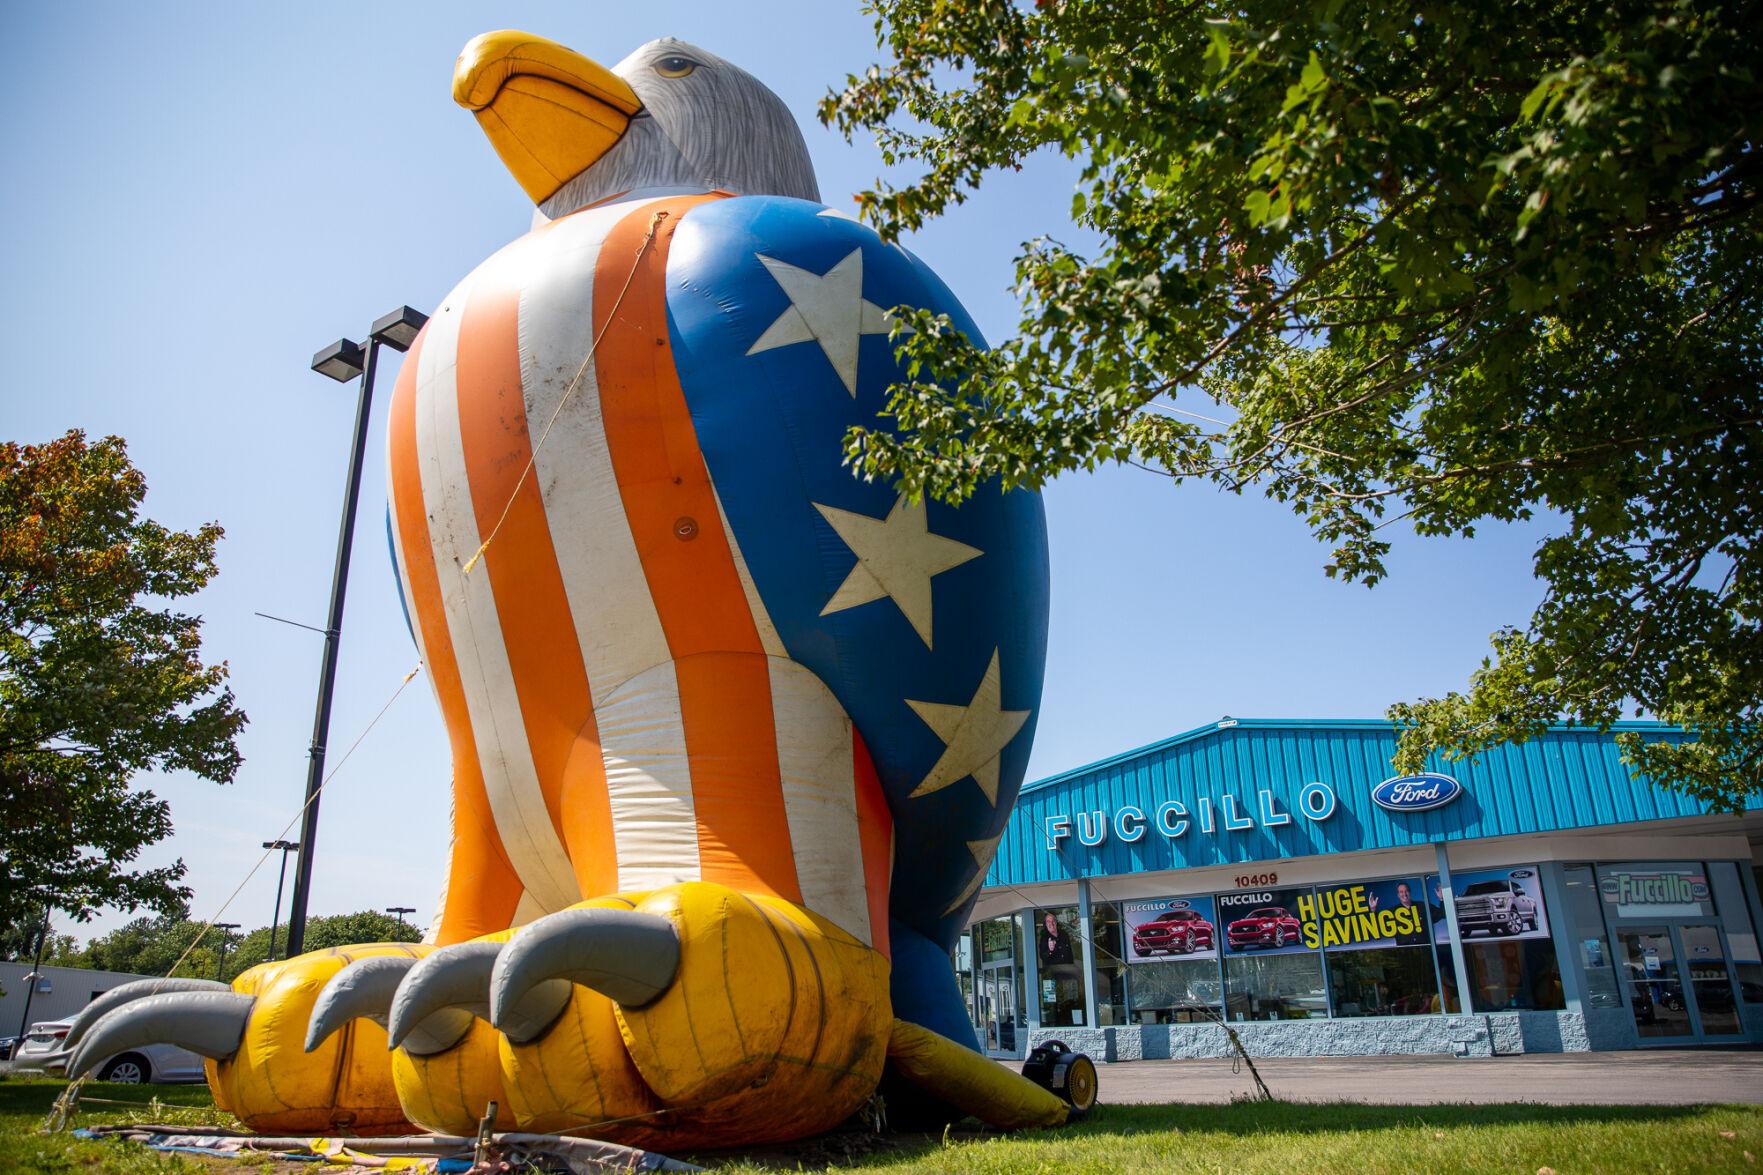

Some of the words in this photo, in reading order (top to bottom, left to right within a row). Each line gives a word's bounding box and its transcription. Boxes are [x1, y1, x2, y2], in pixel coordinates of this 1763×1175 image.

[1390, 780, 1440, 804] Ford
[1045, 781, 1337, 851] FUCCILLO
[1234, 872, 1279, 888] 10409
[1618, 873, 1695, 905] Fuccillo
[1125, 902, 1166, 913] FUCCILLO
[1220, 892, 1273, 907] FUCCILLO
[1297, 885, 1370, 922] HUGE
[1303, 905, 1423, 949] SAVINGS!
